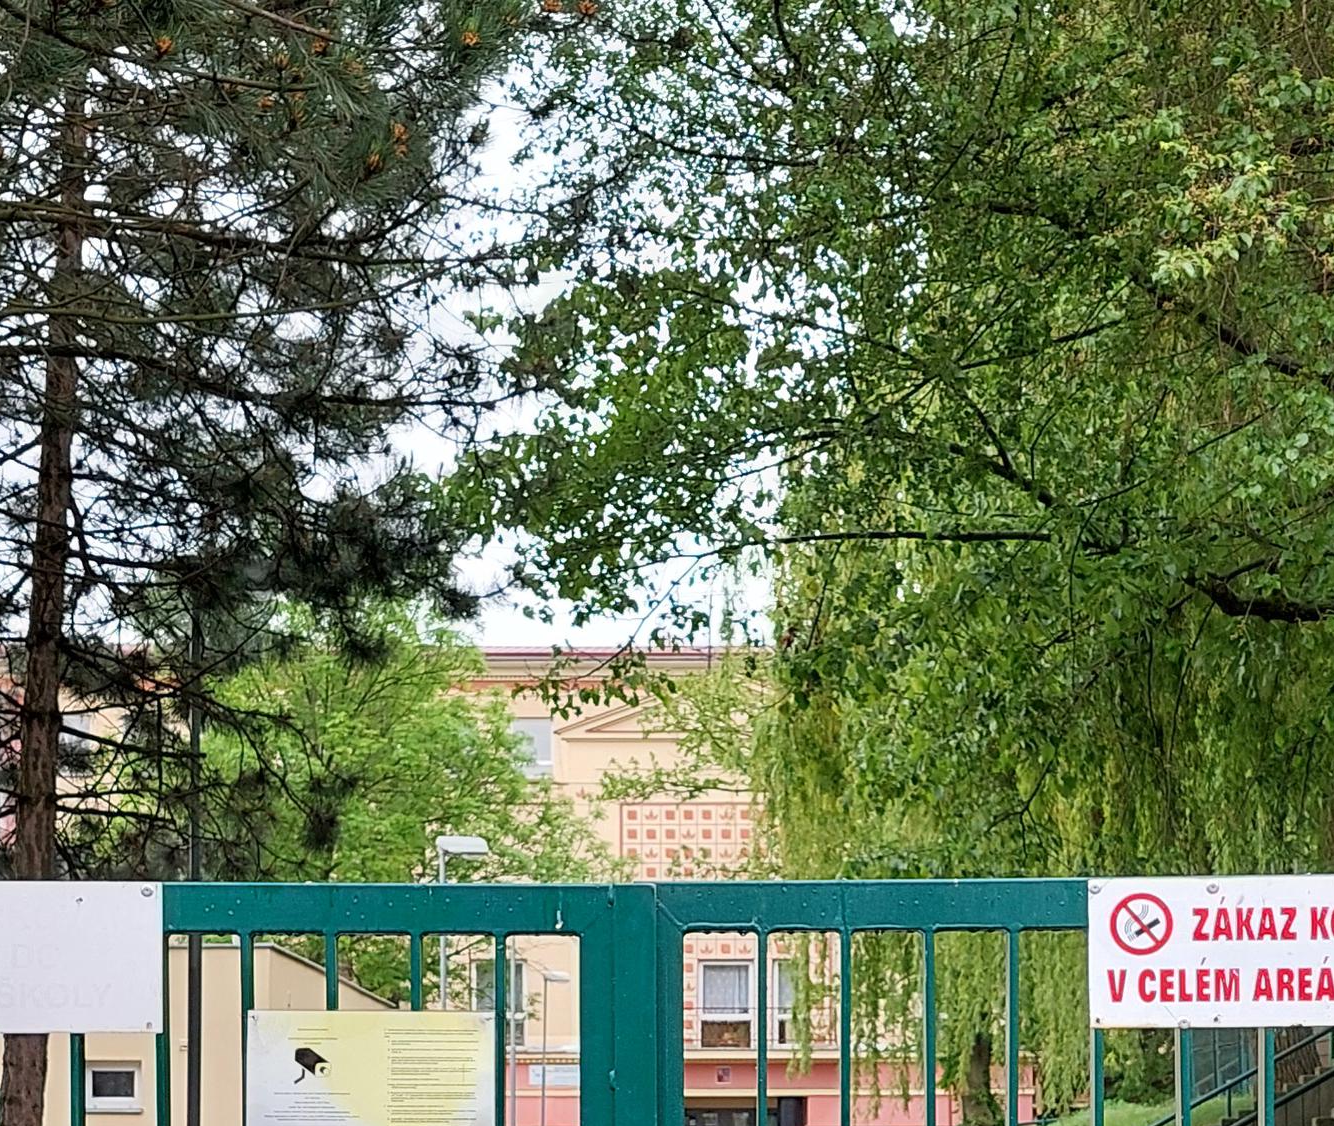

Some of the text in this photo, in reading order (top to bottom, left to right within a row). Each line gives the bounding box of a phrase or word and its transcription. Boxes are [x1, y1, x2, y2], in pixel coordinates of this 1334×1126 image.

[1192, 896, 1298, 941] ZÁKAZ
[1107, 968, 1126, 1003] V
[1137, 957, 1241, 1003] CELÉM
